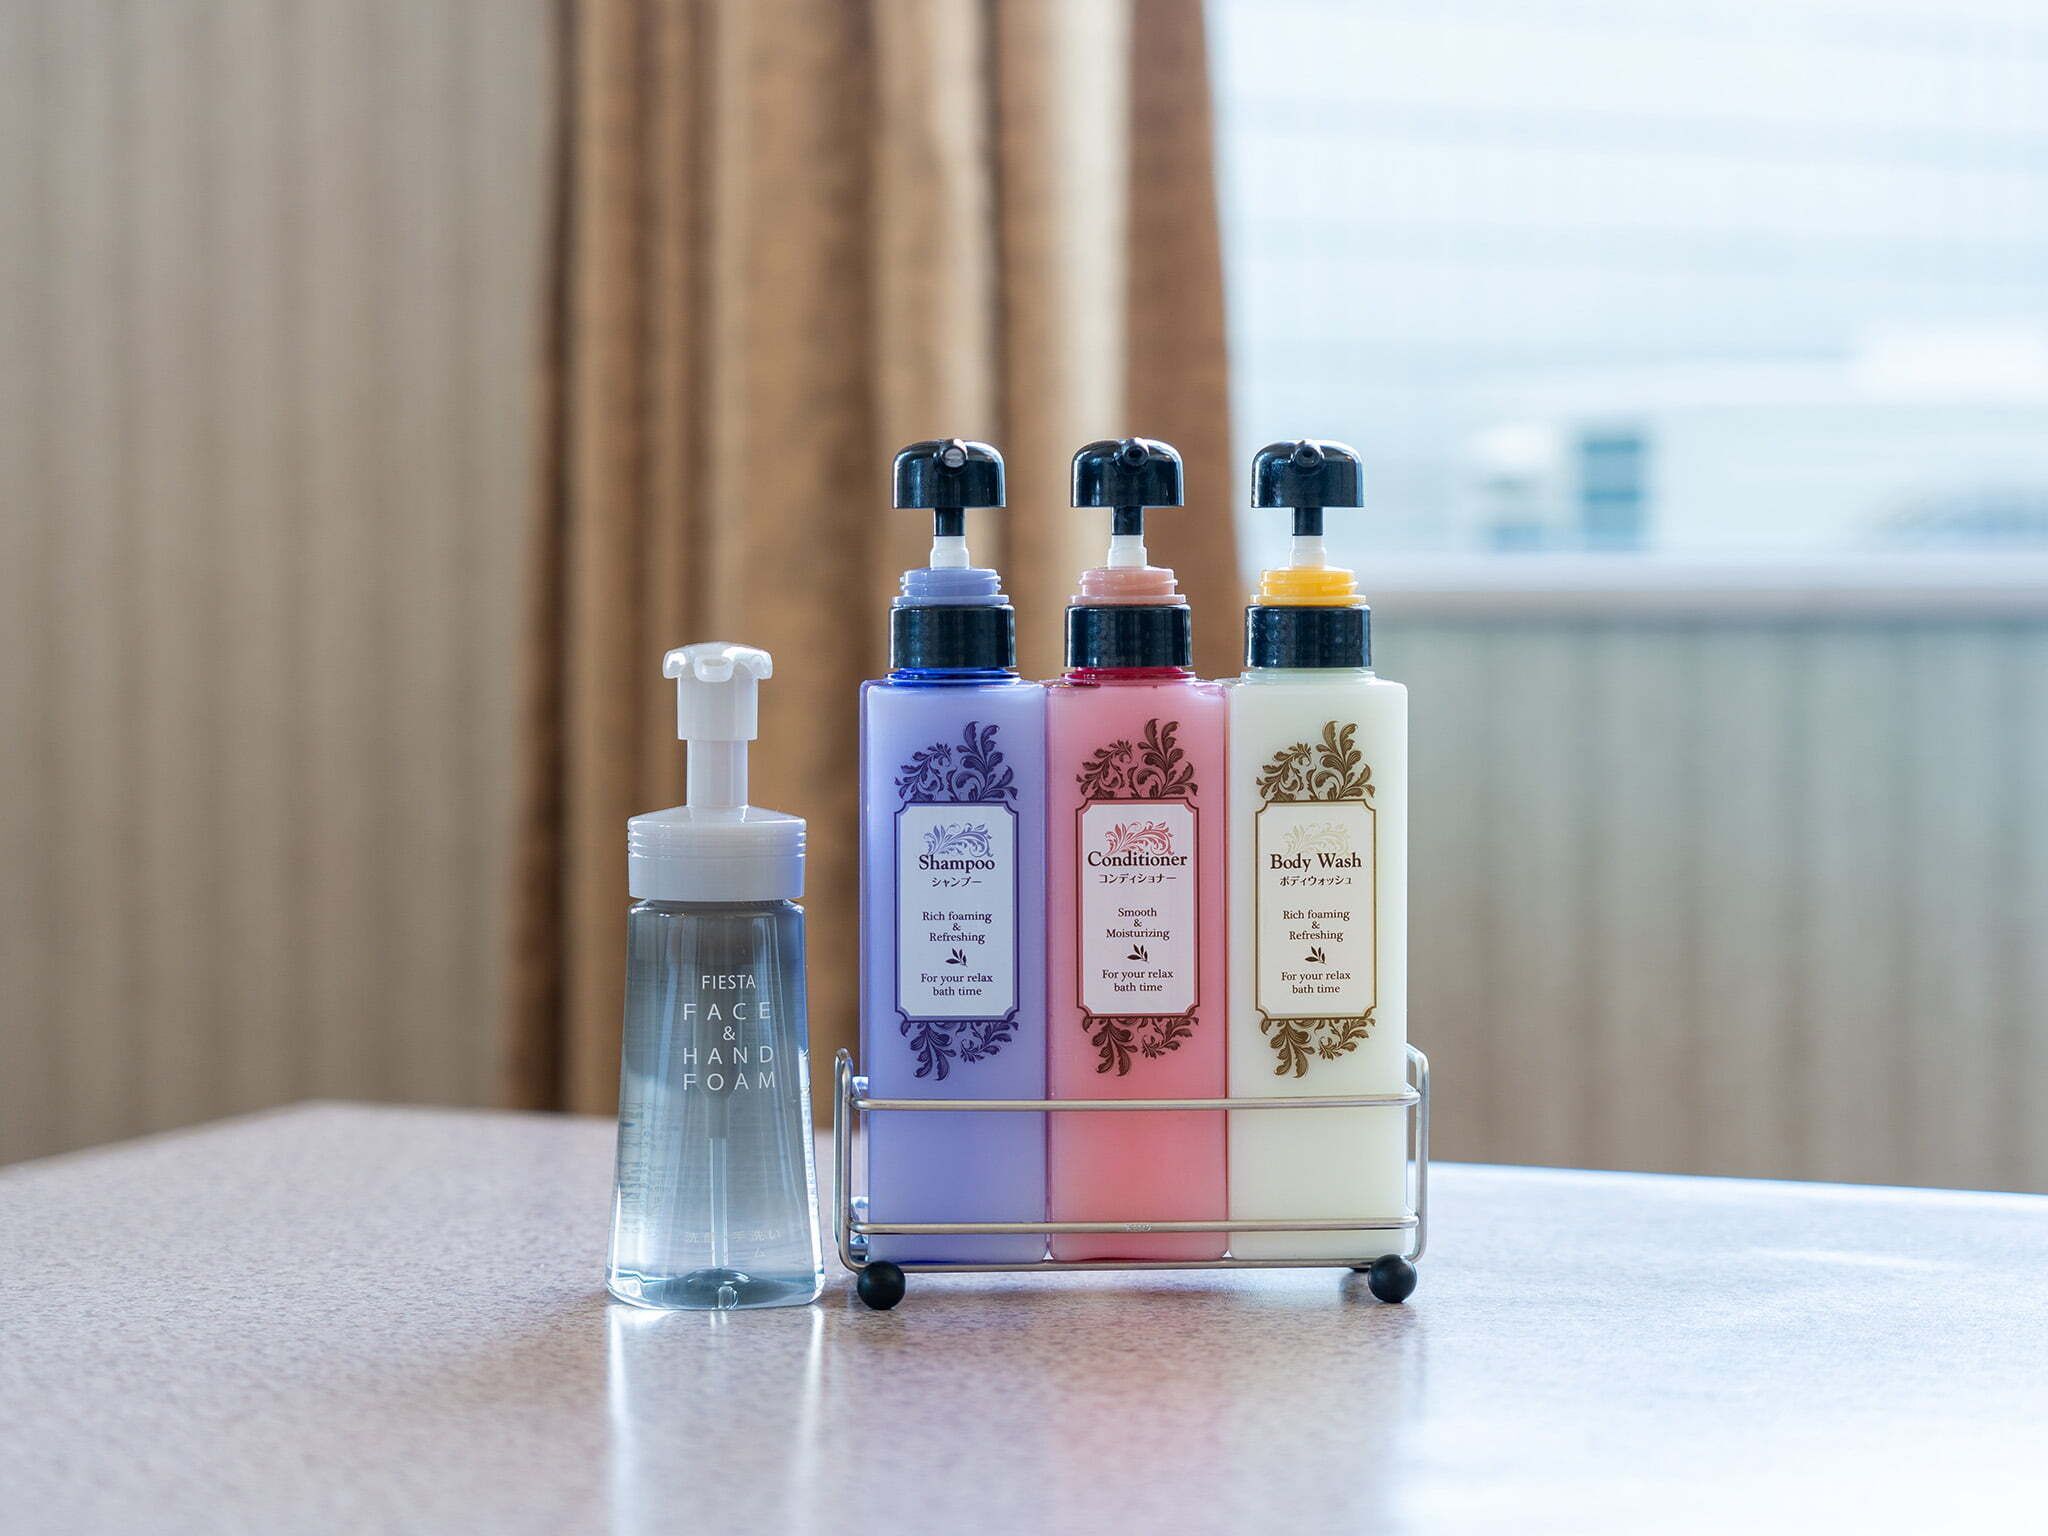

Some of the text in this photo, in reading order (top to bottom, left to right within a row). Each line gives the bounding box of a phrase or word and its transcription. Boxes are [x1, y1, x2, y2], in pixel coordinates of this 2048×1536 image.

[919, 854, 995, 873] Shampoo
[1087, 851, 1188, 867] Conditioner
[1270, 852, 1362, 872] Body Wash
[1099, 873, 1177, 884] コンディショナー
[922, 911, 992, 923] Rich foaming
[1118, 908, 1157, 917] Smooth
[1283, 909, 1351, 921] Rich foaming
[952, 923, 961, 932] &
[1133, 919, 1142, 928] &
[1311, 921, 1320, 930] &
[929, 932, 986, 945] Refreshing
[1106, 929, 1170, 940] Moisturizing
[1289, 930, 1344, 942] Refreshing
[921, 973, 993, 986] For your relax
[1102, 969, 1174, 982] For your relax
[1281, 971, 1351, 984] For your relax
[702, 974, 756, 990] FIESTA
[1114, 983, 1163, 992] bath time
[932, 986, 982, 996] bath time
[1292, 984, 1340, 994] bath time
[683, 1001, 771, 1021] FACE
[722, 1025, 736, 1041] &
[683, 1045, 774, 1065] HAND
[683, 1071, 776, 1091] FOAM
